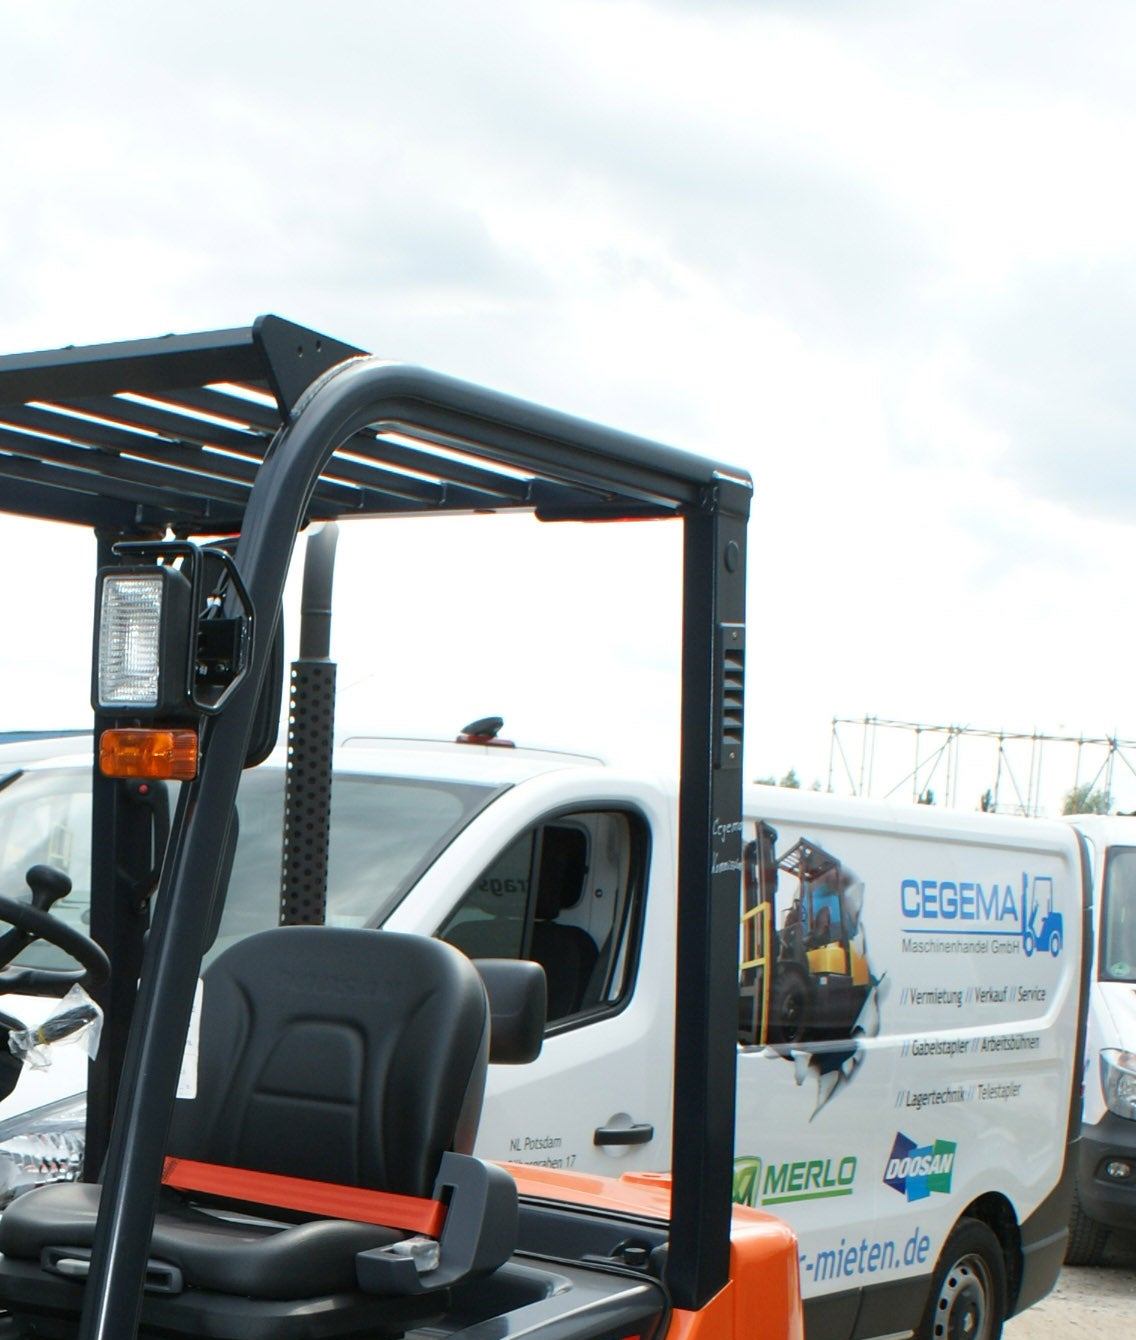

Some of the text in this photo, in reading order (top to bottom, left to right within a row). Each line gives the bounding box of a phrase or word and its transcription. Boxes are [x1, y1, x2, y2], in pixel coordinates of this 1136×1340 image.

[901, 879, 1018, 921] CEGEMA
[902, 938, 1020, 954] Maschinenhandel GmbH
[910, 987, 963, 1008] Vermietung
[975, 986, 1008, 1004] Verkauf
[1018, 986, 1047, 1002] Service
[912, 1038, 969, 1058] Gabelstapler
[981, 1034, 1040, 1053] Arbeitsbühnen
[906, 1086, 965, 1110] Lagertechnik
[978, 1081, 1022, 1102] Telestapler
[510, 1136, 562, 1152] NL Potsdam
[566, 1154, 576, 1168] 17
[886, 1153, 954, 1180] DOOSAN
[763, 1156, 857, 1195] MERLO
